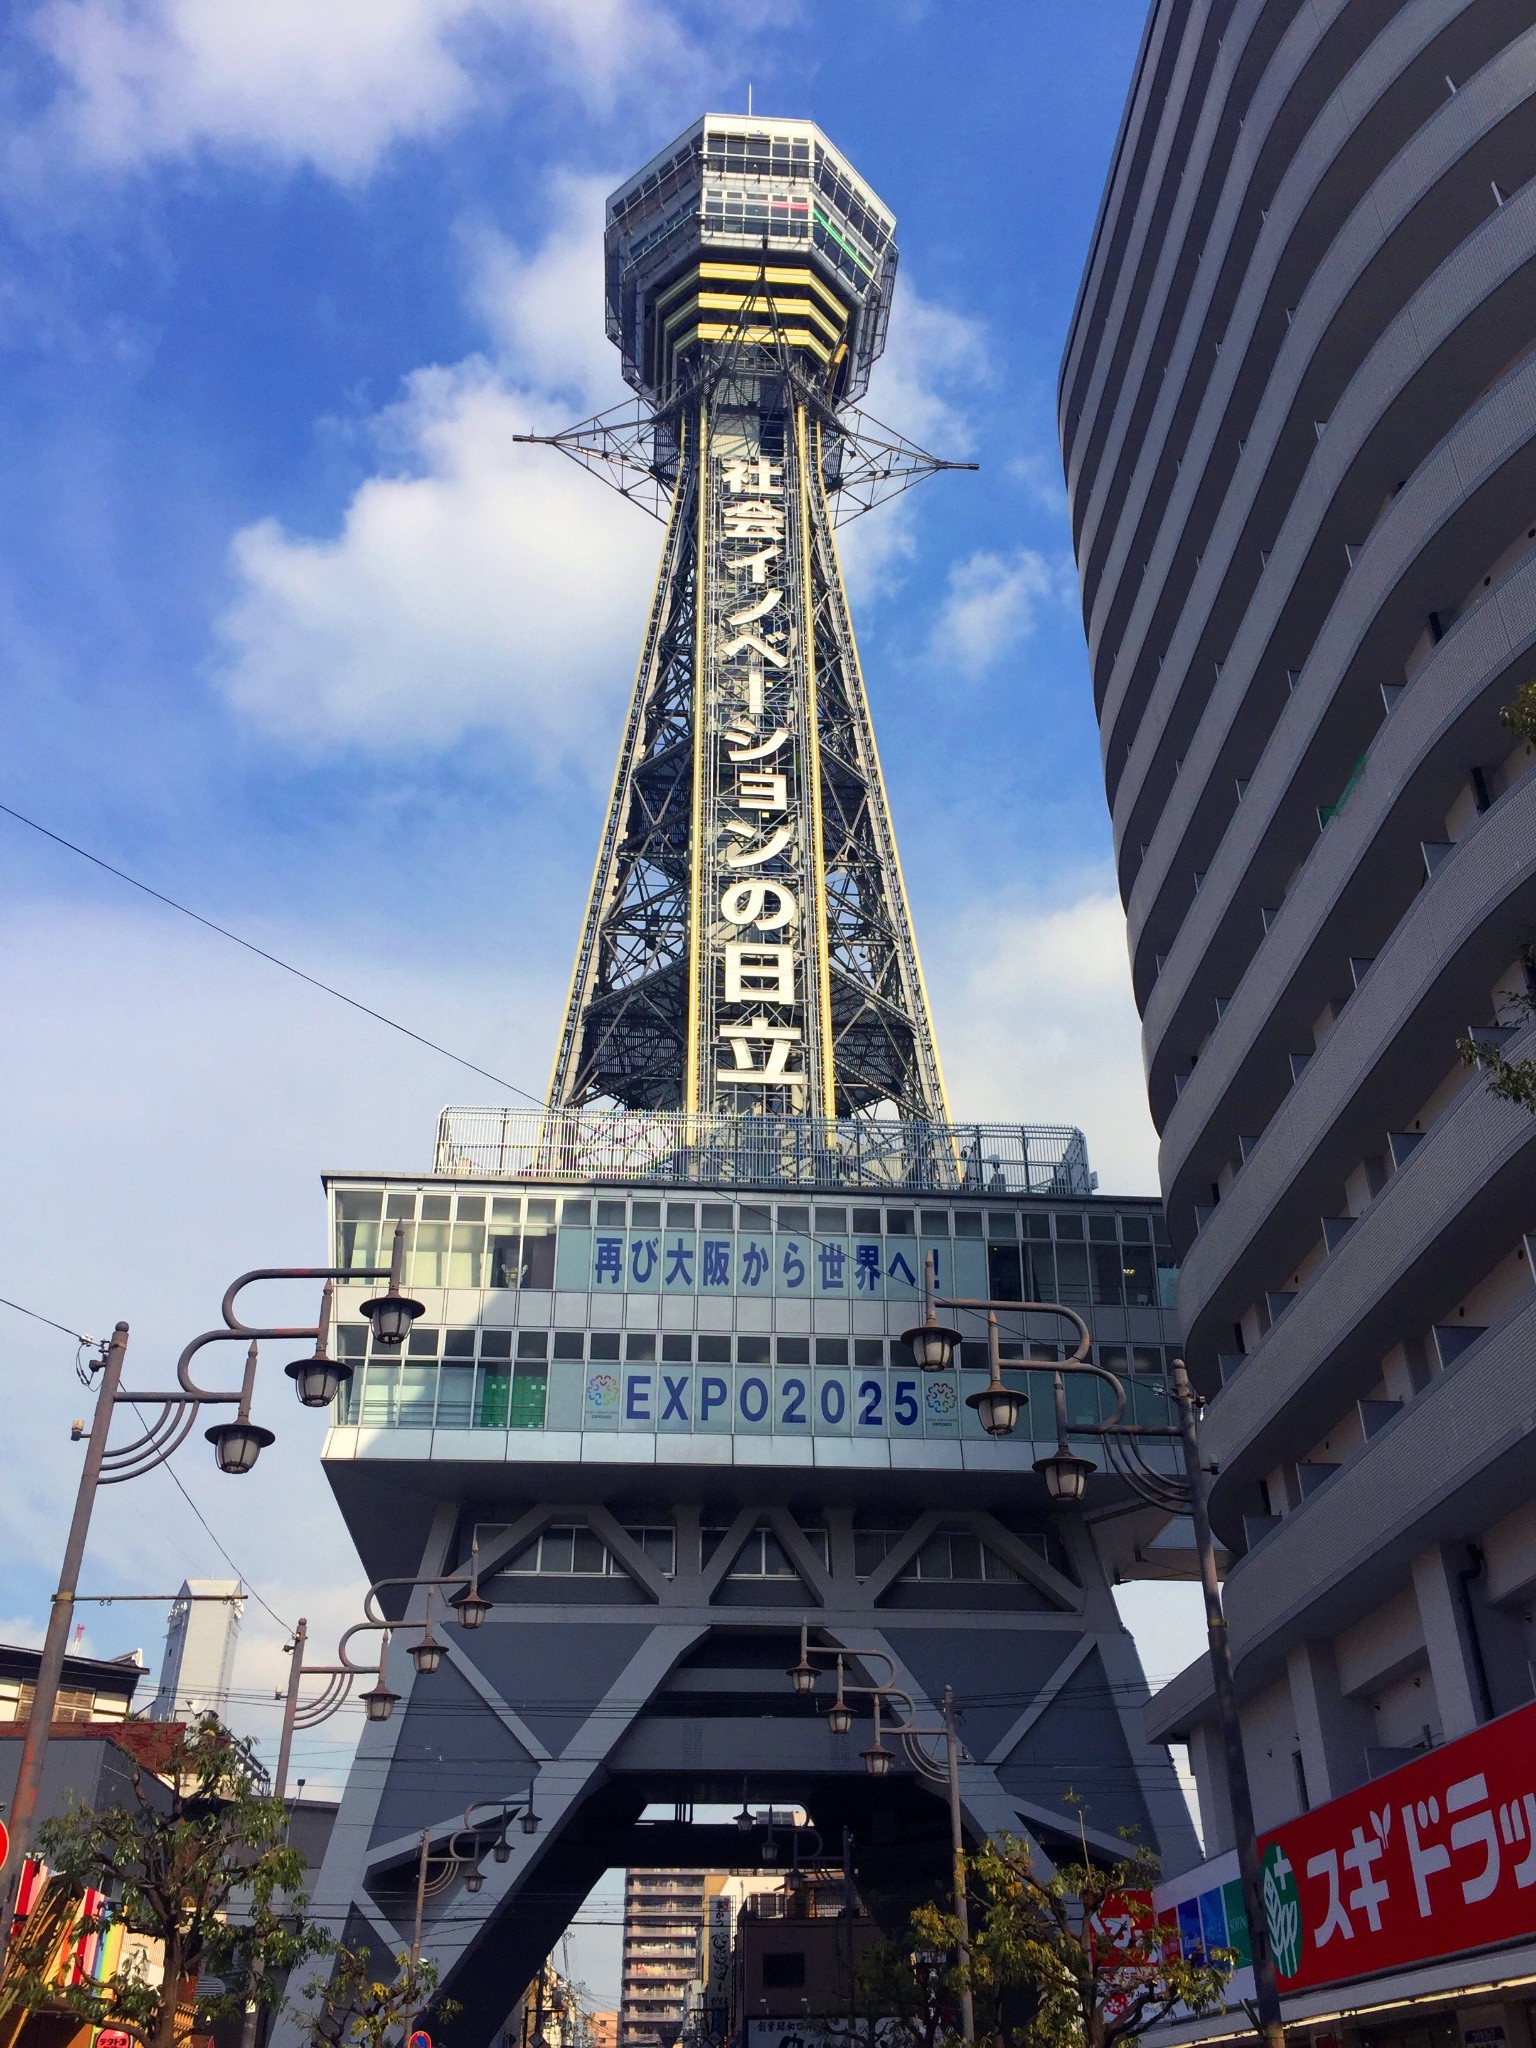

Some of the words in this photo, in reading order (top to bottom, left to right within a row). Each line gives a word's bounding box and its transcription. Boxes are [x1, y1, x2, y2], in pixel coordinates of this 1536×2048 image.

[717, 456, 808, 1085] 社会イノベーションの日立
[595, 1236, 941, 1290] 再び大阪から世界へ!
[625, 1375, 919, 1426] EXPO2025
